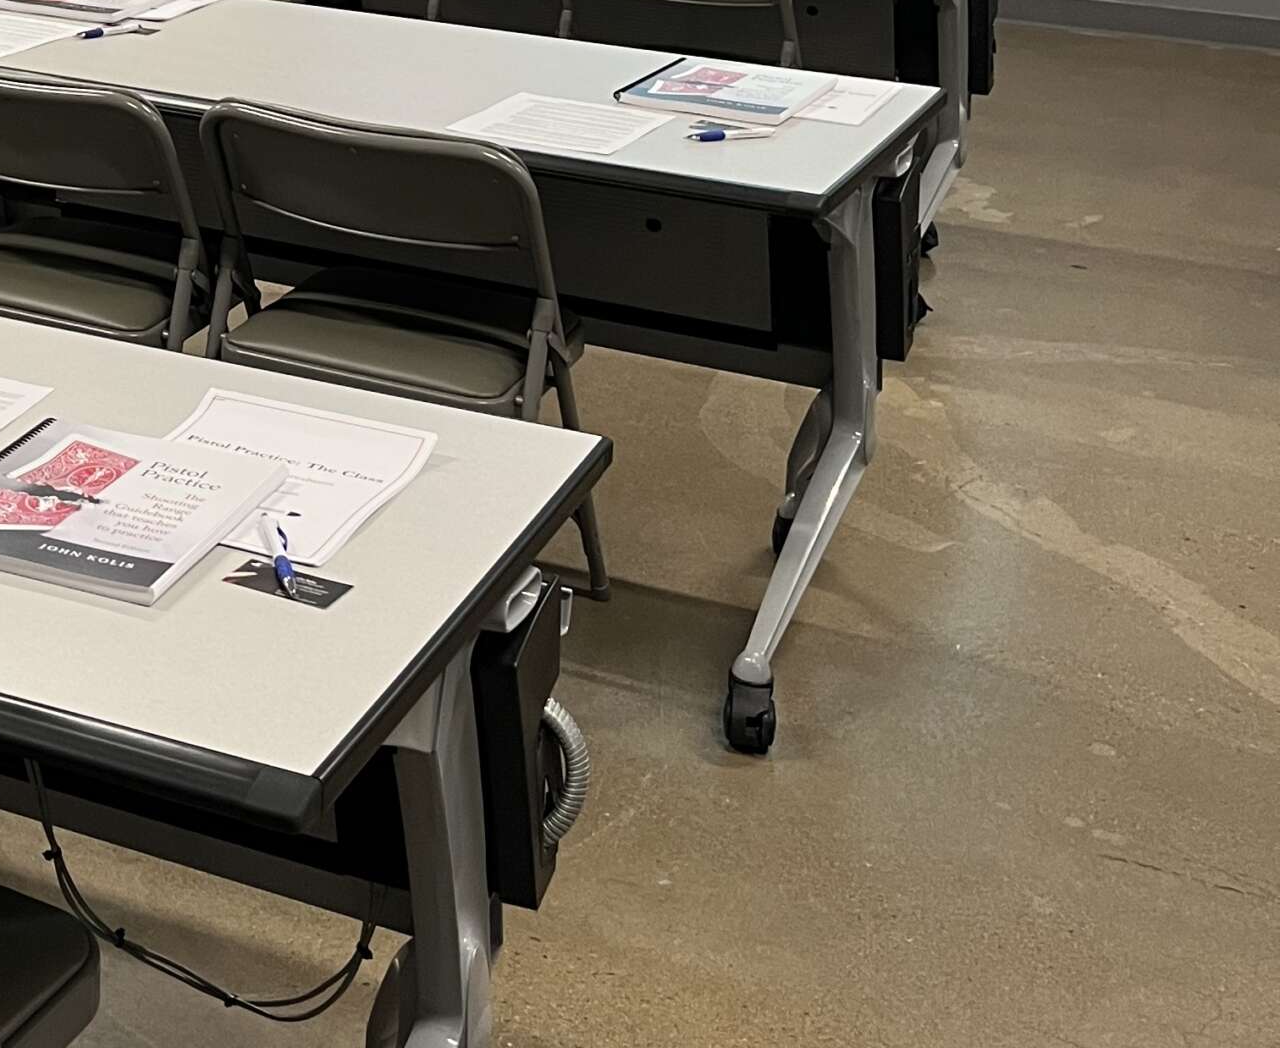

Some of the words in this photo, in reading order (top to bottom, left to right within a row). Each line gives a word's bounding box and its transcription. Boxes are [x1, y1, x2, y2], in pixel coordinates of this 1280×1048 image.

[187, 433, 231, 450] Pistol
[306, 461, 338, 474] The
[341, 468, 385, 484] Class
[149, 460, 209, 479] Pistol
[139, 468, 223, 492] Practice
[142, 492, 200, 510] Shooting
[183, 492, 207, 503] The
[103, 508, 129, 521] that
[115, 502, 184, 523] Guidebook
[151, 501, 194, 516] Range
[110, 527, 165, 543] practice
[142, 525, 171, 536] how
[37, 543, 82, 558] JOHN
[86, 554, 136, 569] KOLIS
